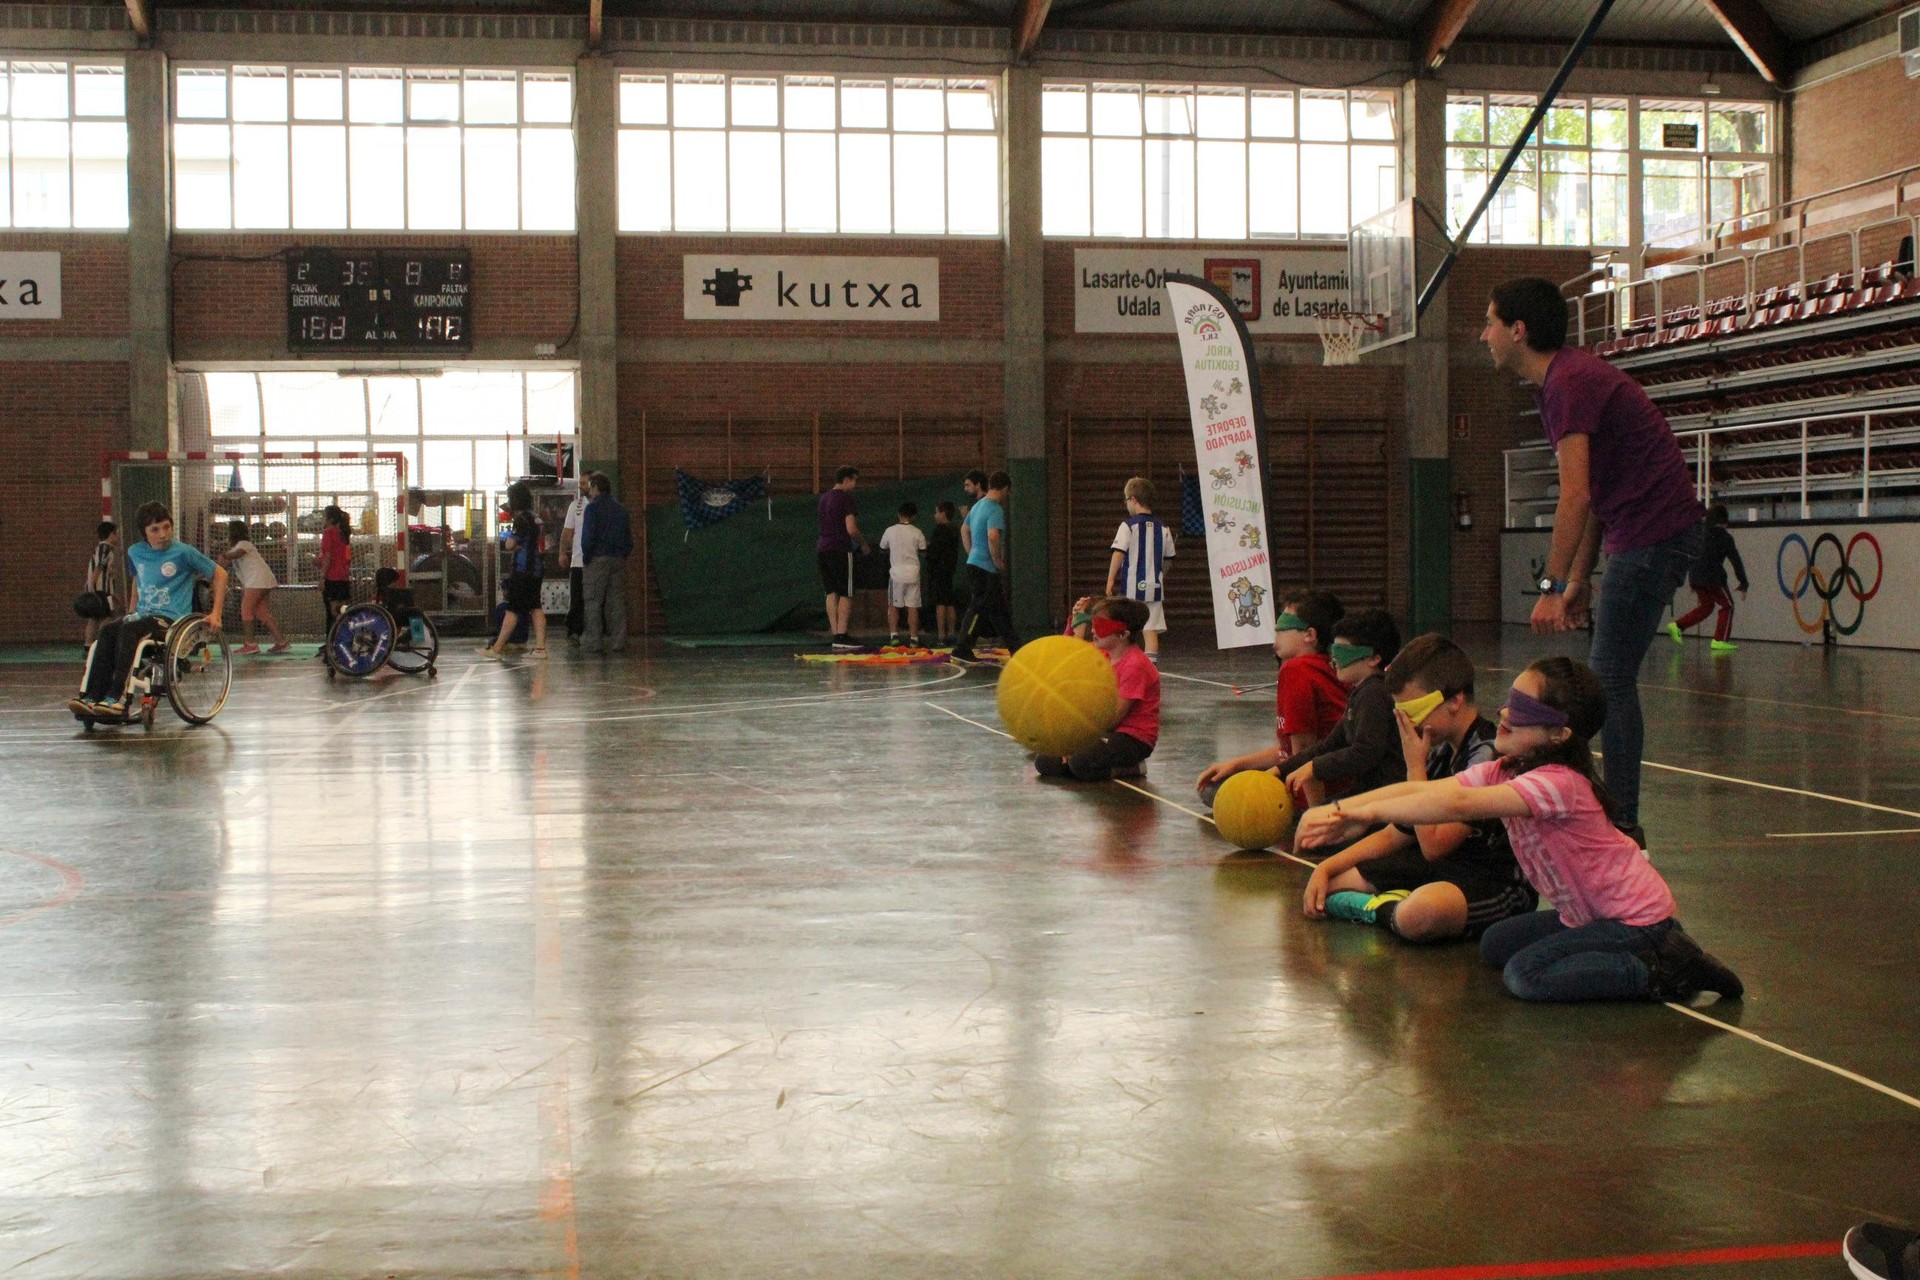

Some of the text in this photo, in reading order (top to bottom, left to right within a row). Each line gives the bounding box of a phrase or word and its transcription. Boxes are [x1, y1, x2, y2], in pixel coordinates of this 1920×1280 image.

[441, 284, 468, 293] FALTAK
[777, 271, 922, 308] kutxa
[1118, 295, 1160, 316] Udala
[1273, 297, 1290, 316] de
